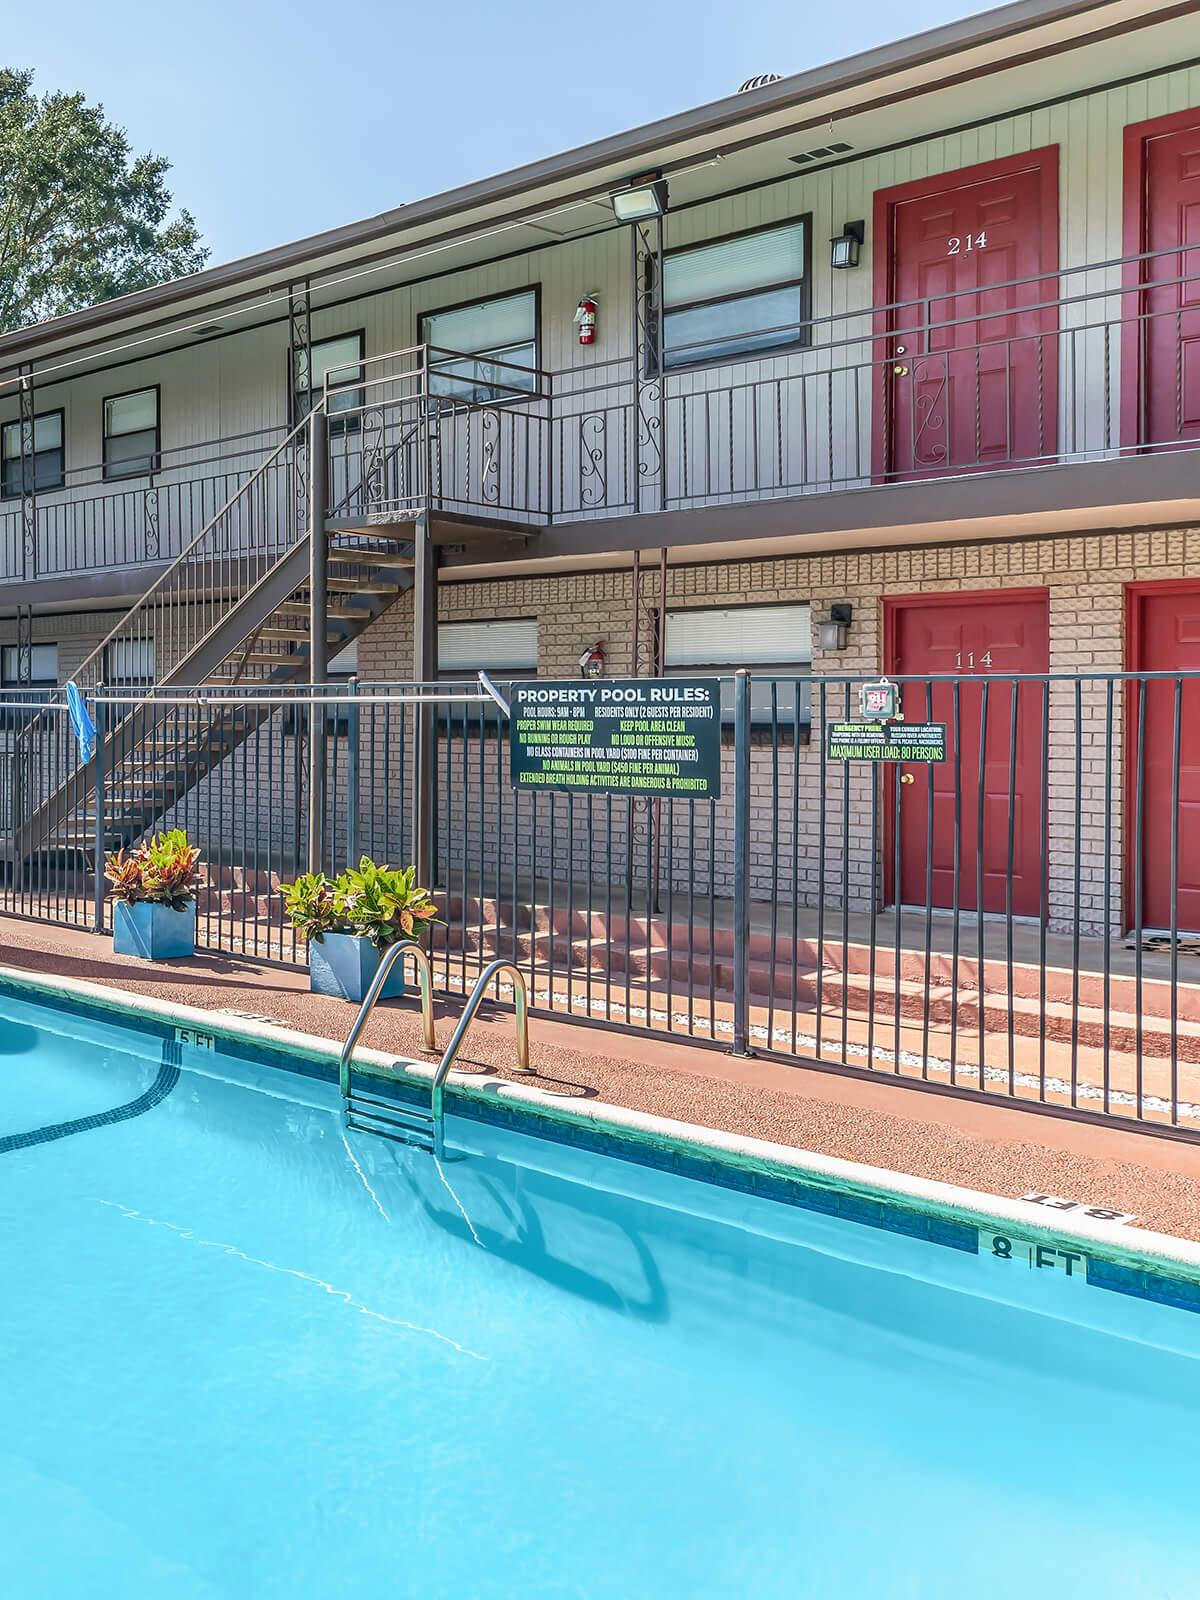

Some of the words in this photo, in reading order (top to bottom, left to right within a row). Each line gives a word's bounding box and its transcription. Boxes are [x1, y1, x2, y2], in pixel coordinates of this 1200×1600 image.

[948, 231, 987, 255] 214
[954, 651, 992, 669] 114
[518, 689, 598, 702] PROPERTY
[601, 688, 646, 702] POOL
[650, 688, 710, 701] RULES:
[523, 706, 536, 718] POOL
[537, 706, 556, 718] HOURS:
[557, 706, 569, 718] 9AM
[572, 706, 585, 718] 8PM
[594, 706, 624, 718] RESIDENTS
[625, 706, 639, 718] ONLY
[647, 706, 668, 718] GUESTS
[670, 706, 680, 718] PER
[682, 706, 713, 719] RESIDENT)
[517, 720, 536, 730] PROPER
[537, 720, 551, 731] SWIM
[552, 720, 567, 731] WEAR
[568, 720, 594, 731] REQUIRED
[620, 720, 634, 731] KEEP
[635, 720, 650, 732] POOL
[650, 721, 665, 732] AREA
[666, 721, 685, 732] CLEAN
[520, 733, 527, 743] NO
[528, 733, 550, 744] RUNNING
[551, 734, 558, 744] OR
[559, 734, 577, 744] ROUGH
[578, 734, 591, 744] PLAY
[611, 734, 620, 745] NO
[620, 734, 635, 745] LOUD
[636, 735, 644, 745] OR
[645, 735, 675, 746] OFFENSIVE
[676, 735, 695, 746] MUSIC
[527, 746, 534, 757] NO
[535, 747, 551, 758] GLASS
[552, 747, 583, 758] CONTAINERS
[584, 747, 590, 758] IN
[591, 747, 605, 758] POOL
[606, 748, 620, 759] YARD
[621, 748, 637, 760] ($100
[638, 748, 651, 760] FINE
[652, 749, 662, 760] PER
[664, 749, 698, 762] CONTAINER)
[831, 745, 862, 757] MAXIMUM
[863, 746, 880, 758] USER
[881, 746, 900, 758] LOAD:
[901, 746, 911, 759] 80
[912, 746, 943, 760] PERSONS
[542, 760, 550, 770] NO
[551, 760, 574, 771] ANIMALS
[575, 761, 581, 771] IN
[582, 761, 596, 772] POOL
[596, 761, 610, 772] YARD
[611, 761, 628, 774] ($450
[629, 762, 642, 773] FINE
[642, 763, 654, 774] PER
[654, 763, 680, 776] ANIMAL)
[520, 772, 545, 783] EXTENDED
[546, 773, 565, 784] BREATH
[566, 774, 589, 785] HOLDING
[590, 775, 618, 786] ACTIVITIES
[619, 776, 630, 787] ARE
[631, 777, 665, 788] DANGEROUS
[666, 778, 671, 789] &
[672, 778, 708, 790] PROHIBITED
[181, 1030, 189, 1044] 5
[196, 1035, 213, 1048] FT
[992, 1236, 1013, 1259] 8
[1036, 1245, 1081, 1276] FT
